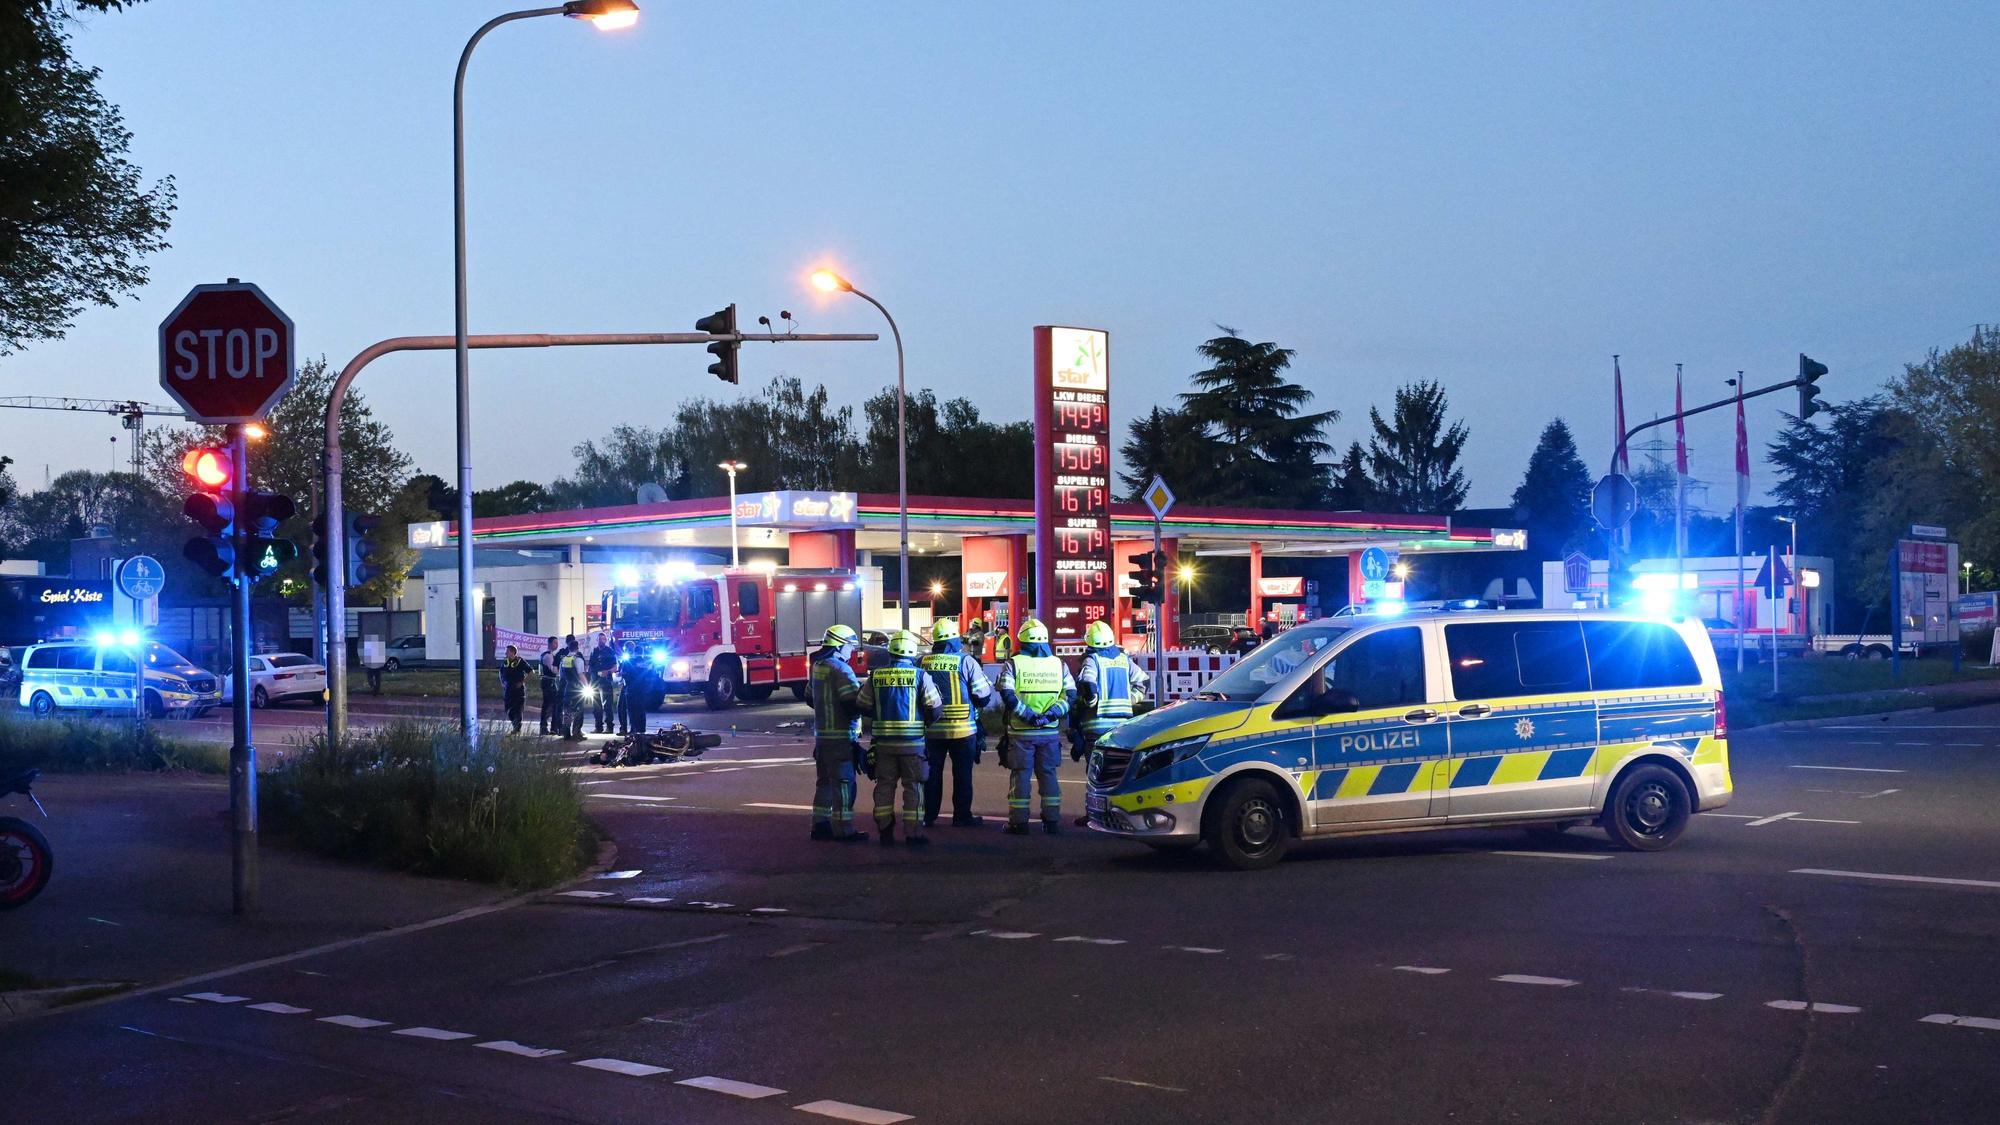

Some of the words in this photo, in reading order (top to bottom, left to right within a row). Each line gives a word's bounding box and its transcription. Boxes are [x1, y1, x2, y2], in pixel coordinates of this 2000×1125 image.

[175, 328, 278, 381] STOP
[1058, 368, 1089, 384] star
[1053, 391, 1075, 401] LKW
[1076, 392, 1106, 404] DIESEL
[1066, 434, 1098, 444] DIESEL
[1057, 476, 1089, 486] SUPER
[1090, 477, 1105, 486] E10
[736, 501, 761, 517] star
[1067, 518, 1098, 528] SUPER
[1056, 560, 1086, 570] SUPER
[1088, 561, 1107, 570] PLUS
[969, 581, 985, 590] star
[874, 678, 888, 686] PUL
[890, 678, 896, 686] 2
[898, 678, 914, 686] ELW
[1341, 730, 1420, 754] POLIZEI
